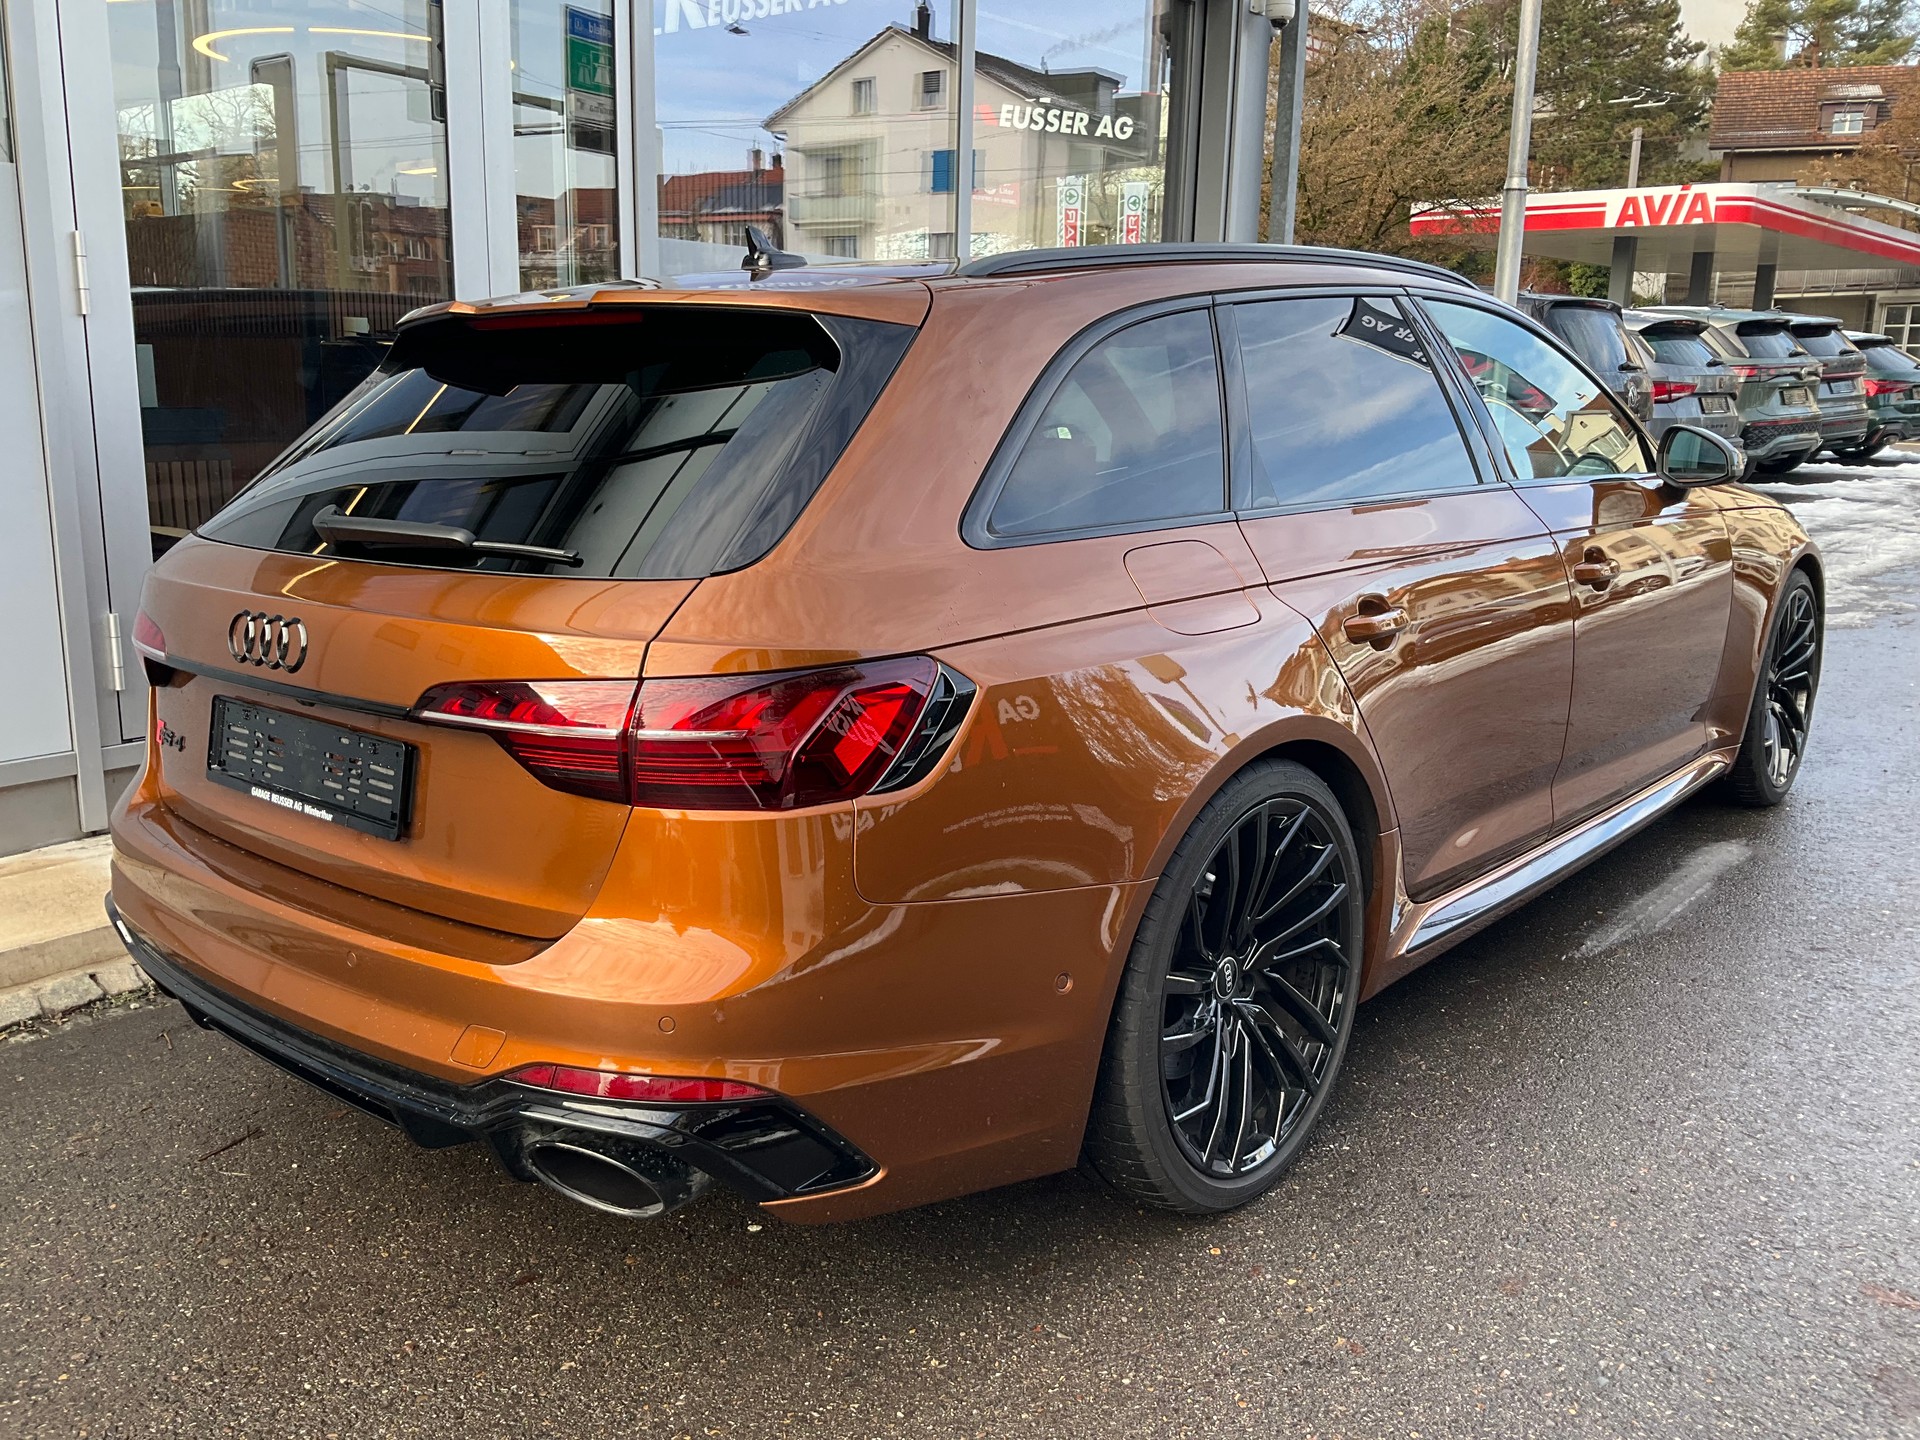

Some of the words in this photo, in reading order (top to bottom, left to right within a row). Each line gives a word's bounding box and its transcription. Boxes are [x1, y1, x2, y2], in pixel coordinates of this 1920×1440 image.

[987, 103, 1090, 137] EUSSER
[1094, 114, 1134, 141] AG
[251, 786, 271, 801] GARAGE
[271, 793, 294, 809] REUSSER
[293, 800, 303, 811] AG
[304, 803, 334, 821] Winterthur
